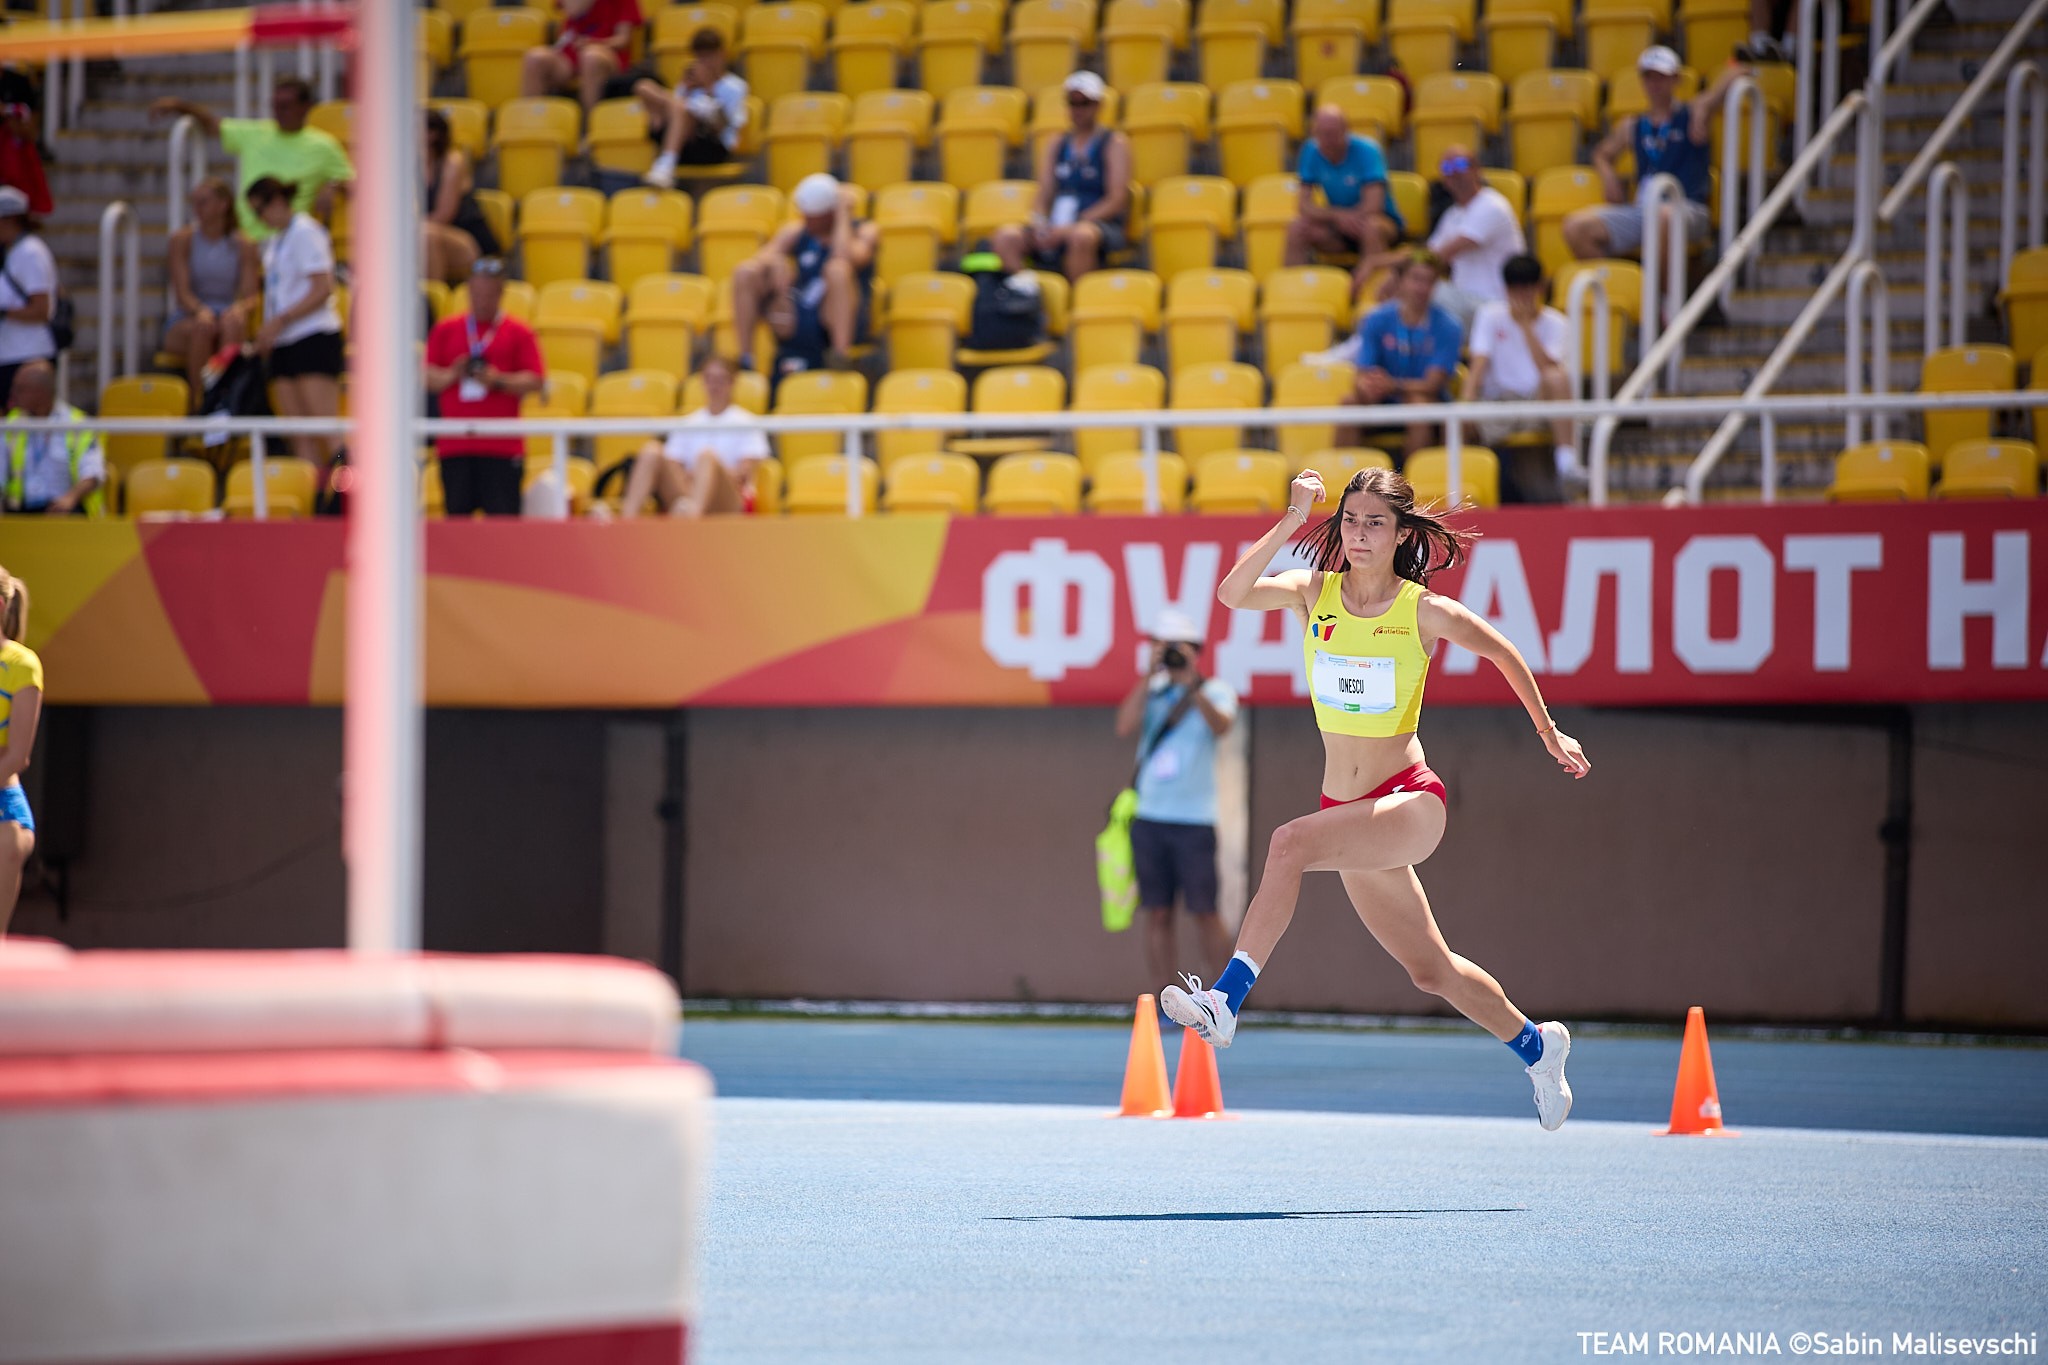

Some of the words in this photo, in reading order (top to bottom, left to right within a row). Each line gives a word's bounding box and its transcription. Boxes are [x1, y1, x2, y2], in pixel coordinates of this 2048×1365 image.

[982, 534, 1883, 697] ФУДАЛОТ
[1927, 530, 2048, 671] Н
[1338, 677, 1365, 694] IONESCU
